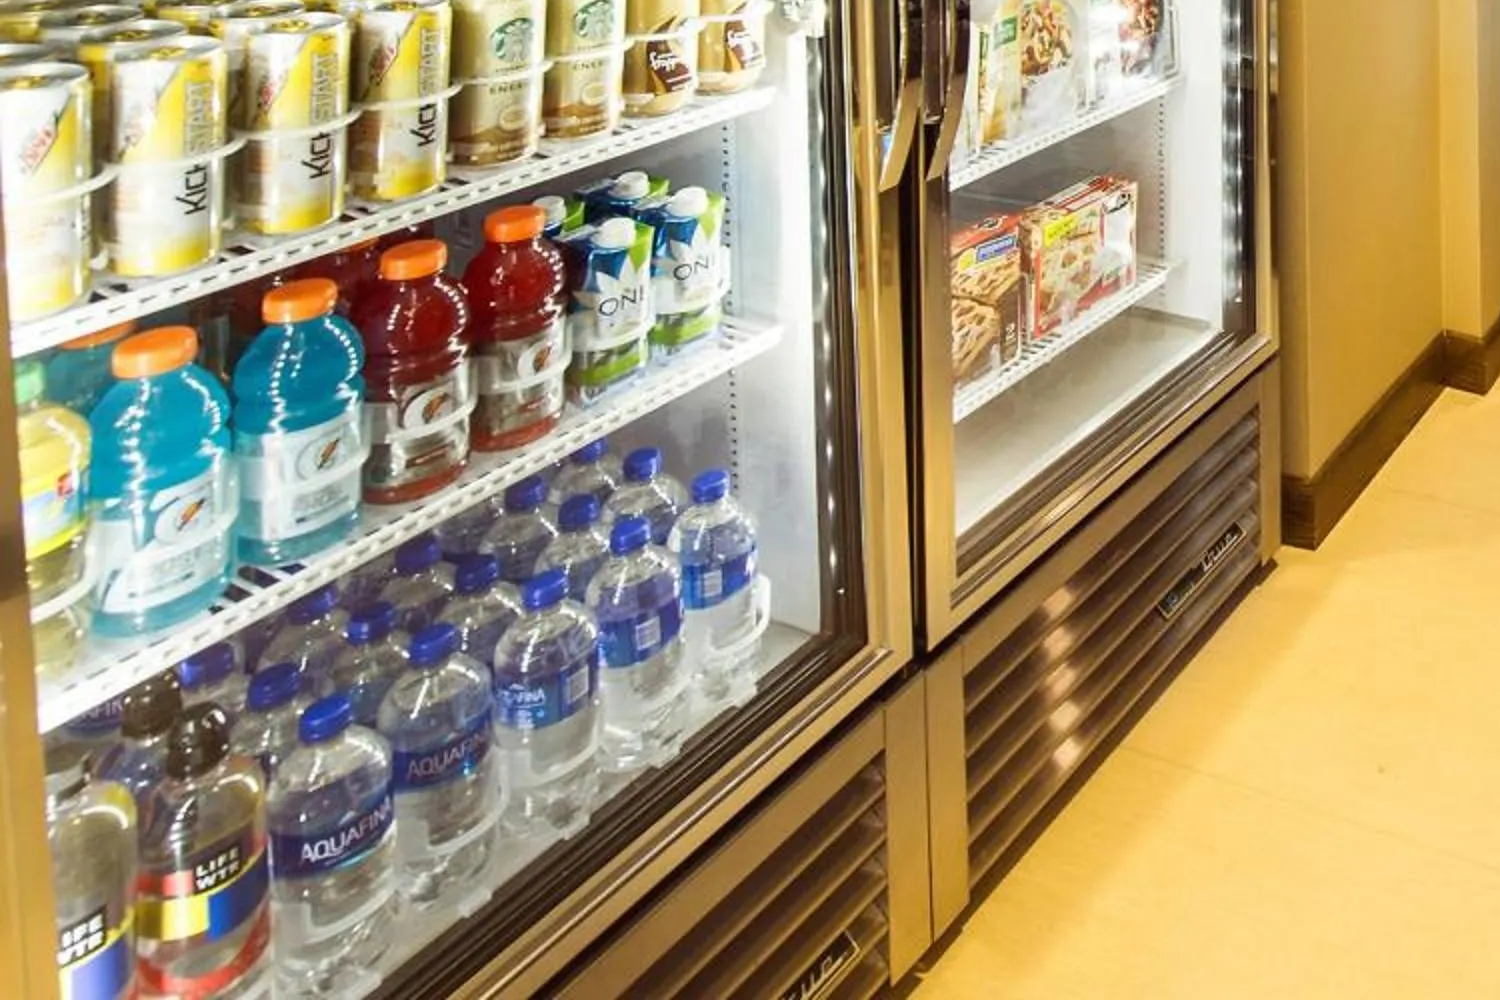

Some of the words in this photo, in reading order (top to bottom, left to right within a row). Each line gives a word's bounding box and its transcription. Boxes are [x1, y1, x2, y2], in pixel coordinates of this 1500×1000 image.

[409, 103, 437, 148] KIC
[196, 847, 240, 877] LIFE
[196, 860, 240, 890] WTR
[61, 912, 103, 949] IFE
